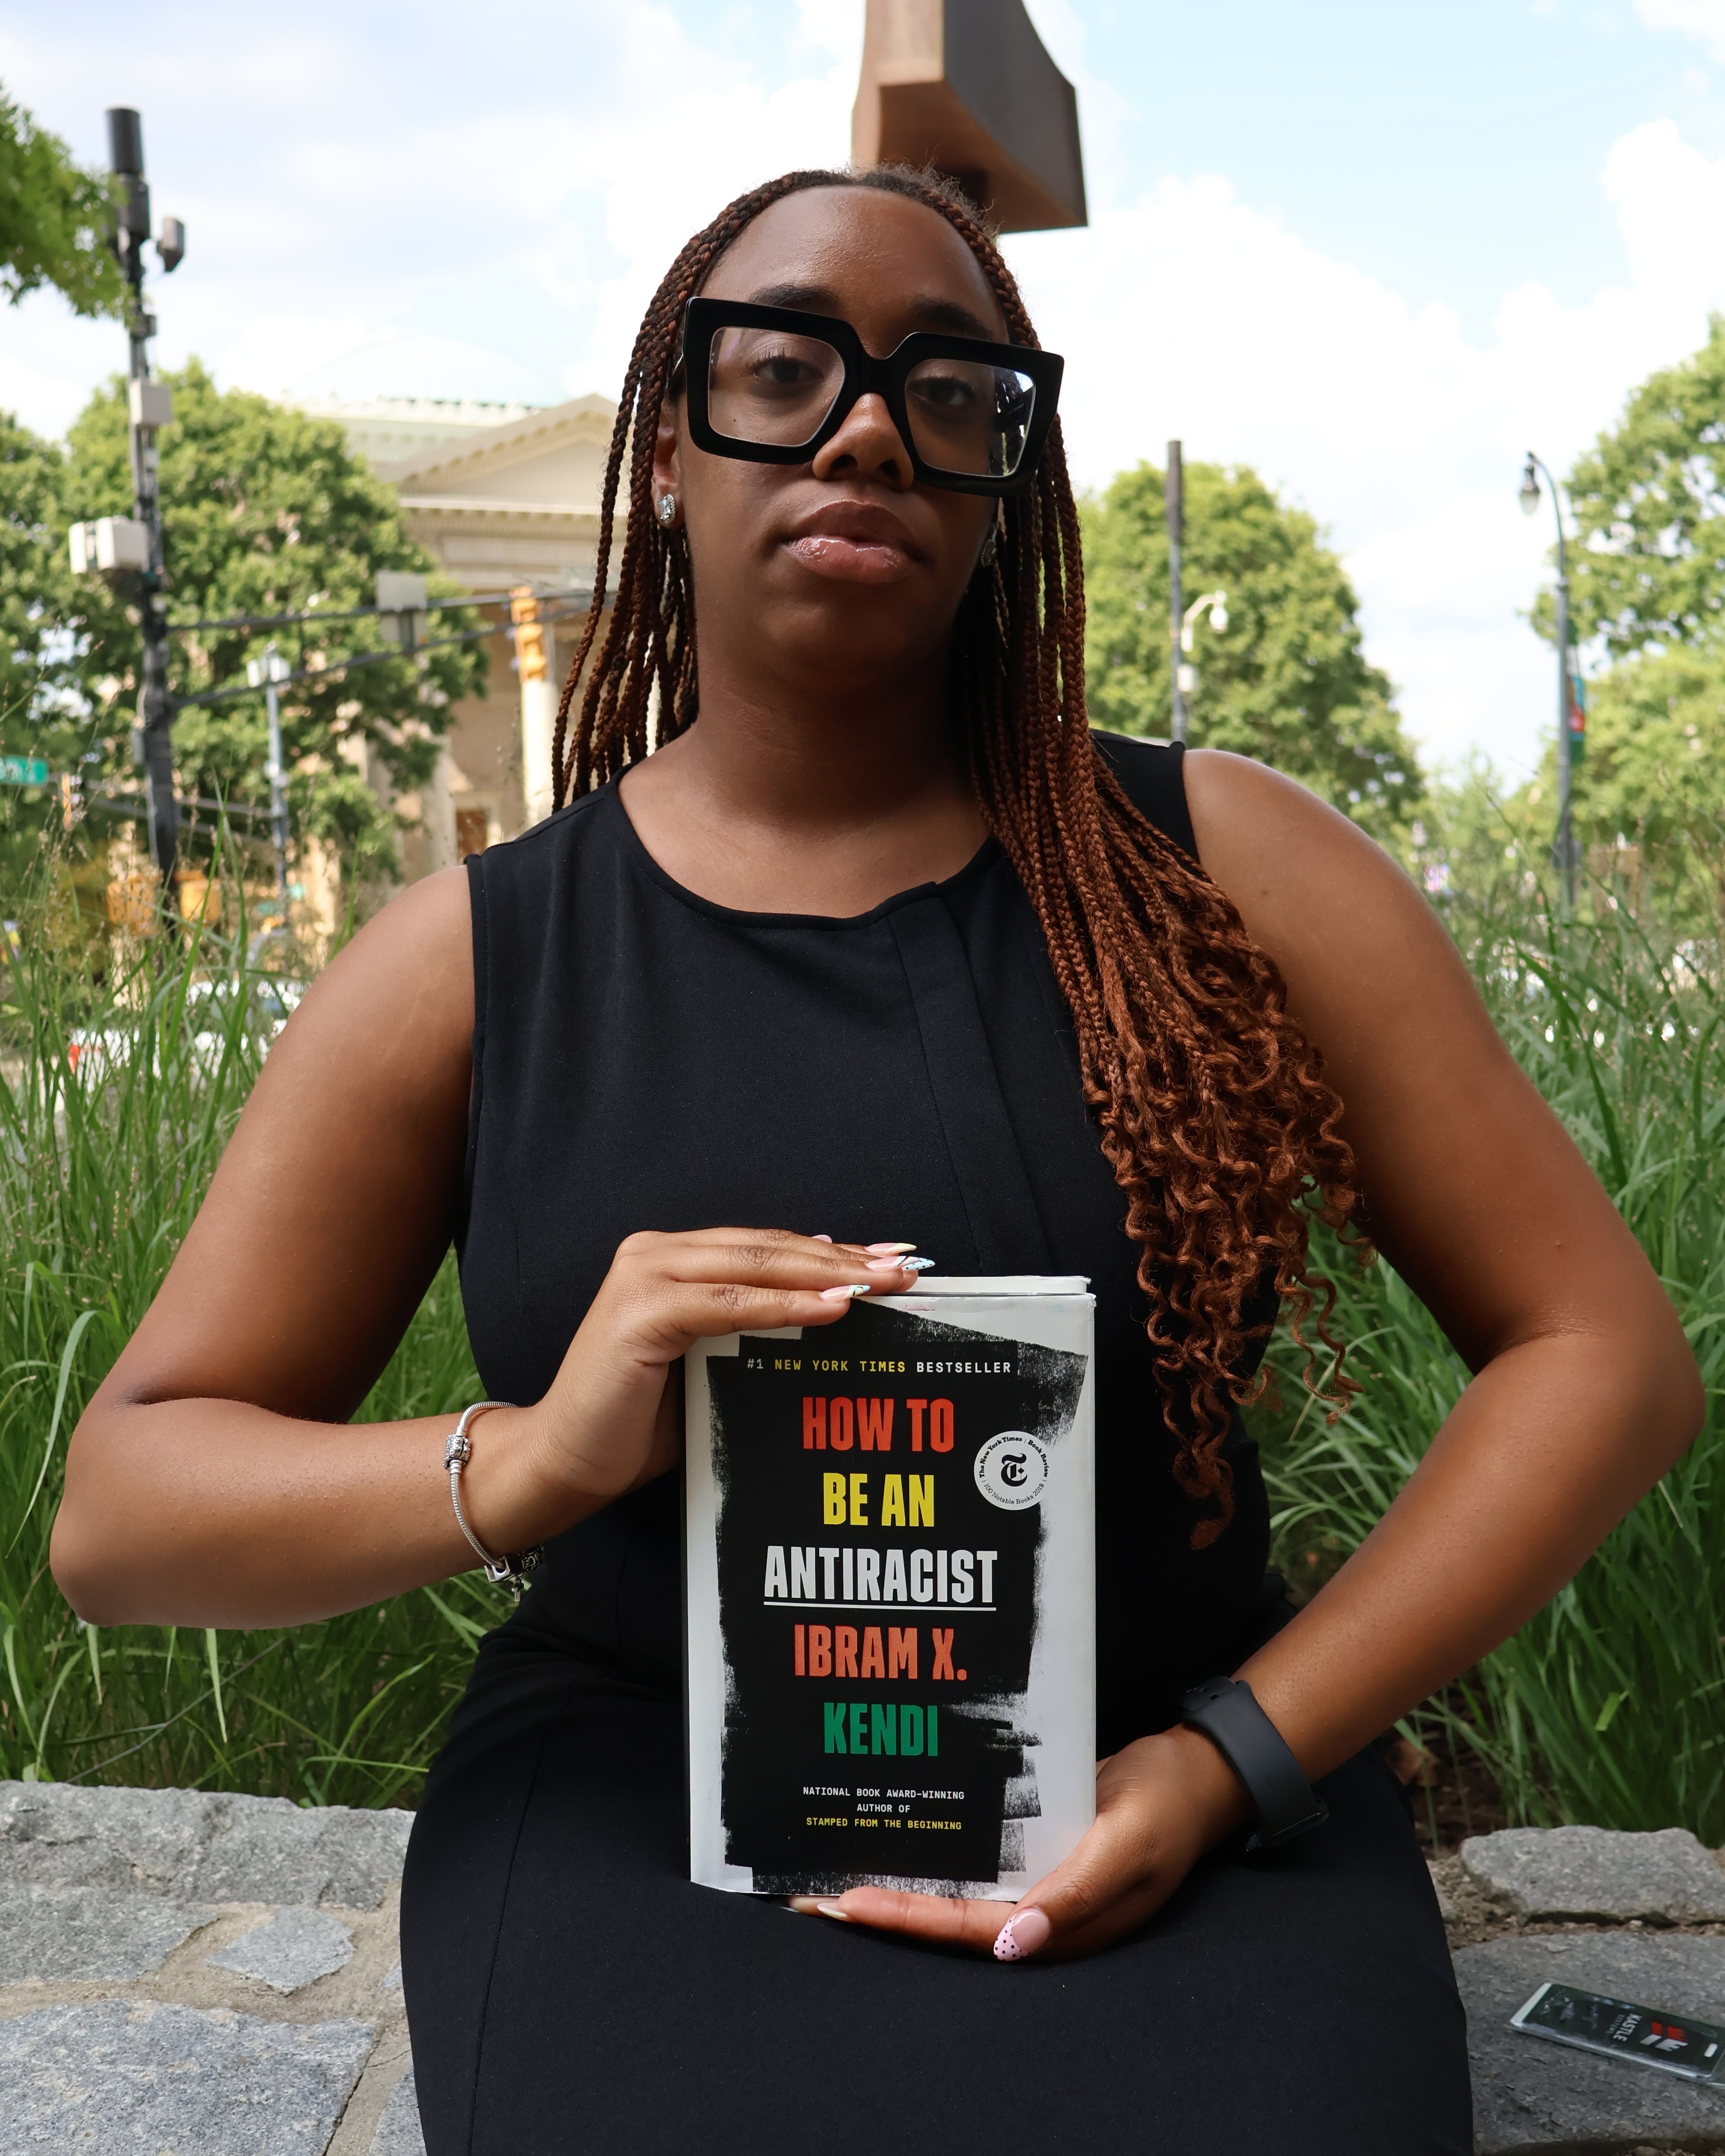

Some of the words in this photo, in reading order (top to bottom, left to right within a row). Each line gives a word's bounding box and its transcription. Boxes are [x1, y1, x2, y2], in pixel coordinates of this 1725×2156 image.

[747, 1358, 764, 1369] #1
[775, 1359, 801, 1370] NEW
[812, 1360, 848, 1371] YORK
[859, 1361, 905, 1372] TIMES
[916, 1362, 1010, 1373] BESTSELLER
[803, 1397, 894, 1451] HOW
[906, 1398, 954, 1453] TO
[980, 1451, 990, 1464] New
[987, 1439, 1002, 1451] York
[1027, 1440, 1042, 1454] Book
[1040, 1454, 1049, 1478] Review
[823, 1472, 868, 1526] BE
[881, 1474, 934, 1527] AN
[984, 1483, 993, 1494] 100
[991, 1492, 1014, 1504] Notable
[1016, 1495, 1034, 1505] Books
[1032, 1483, 1044, 1496] 2019
[764, 1546, 997, 1603] ANTIRACIST
[794, 1624, 918, 1679] IBRAM
[932, 1628, 967, 1681] X.
[824, 1702, 938, 1756] KENDI
[803, 1786, 850, 1796] NATIONAL
[857, 1788, 880, 1797] BOOK
[886, 1789, 964, 1799] AWARD-WINNING
[857, 1803, 893, 1812] AUTHOR
[898, 1804, 910, 1813] OF
[806, 1817, 848, 1827] STAMPED
[854, 1819, 878, 1827] FROM
[884, 1819, 901, 1828] THE
[907, 1820, 961, 1830] BEGINNING
[1613, 2014, 1642, 2041] KASTLE
